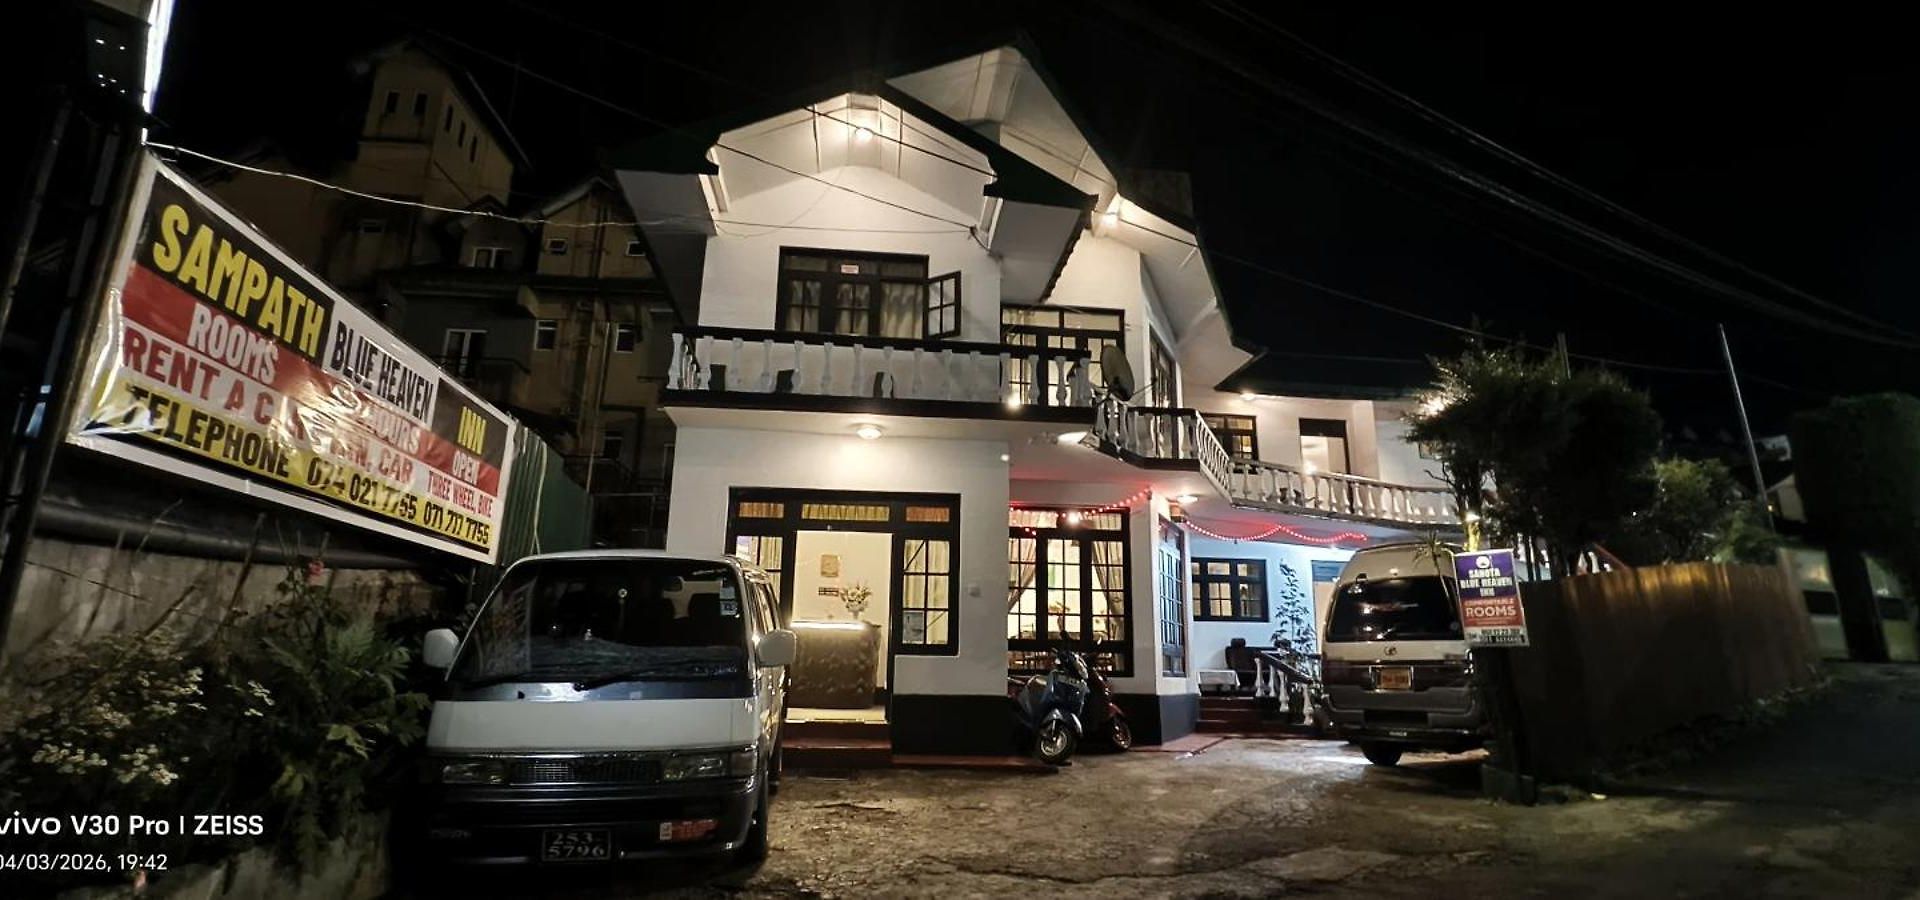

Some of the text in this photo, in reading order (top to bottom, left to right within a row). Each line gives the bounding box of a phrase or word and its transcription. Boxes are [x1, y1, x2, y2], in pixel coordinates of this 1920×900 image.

[153, 204, 325, 358] SAMPATH
[330, 320, 379, 391] BLUE
[377, 353, 434, 425] HEAVEN
[457, 405, 488, 455] INN
[187, 302, 279, 384] ROOMS
[452, 449, 481, 487] OPEN
[122, 326, 221, 401] RENT
[224, 379, 246, 411] A
[378, 447, 415, 485] CAR
[428, 470, 451, 501] THREE
[477, 494, 493, 518] BIKE
[125, 383, 290, 478] TELEPHONE
[349, 473, 378, 507] 021
[423, 501, 444, 530] 071
[465, 516, 490, 545] 7755
[1460, 578, 1481, 590] BLUE
[1466, 605, 1517, 618] ROOMS
